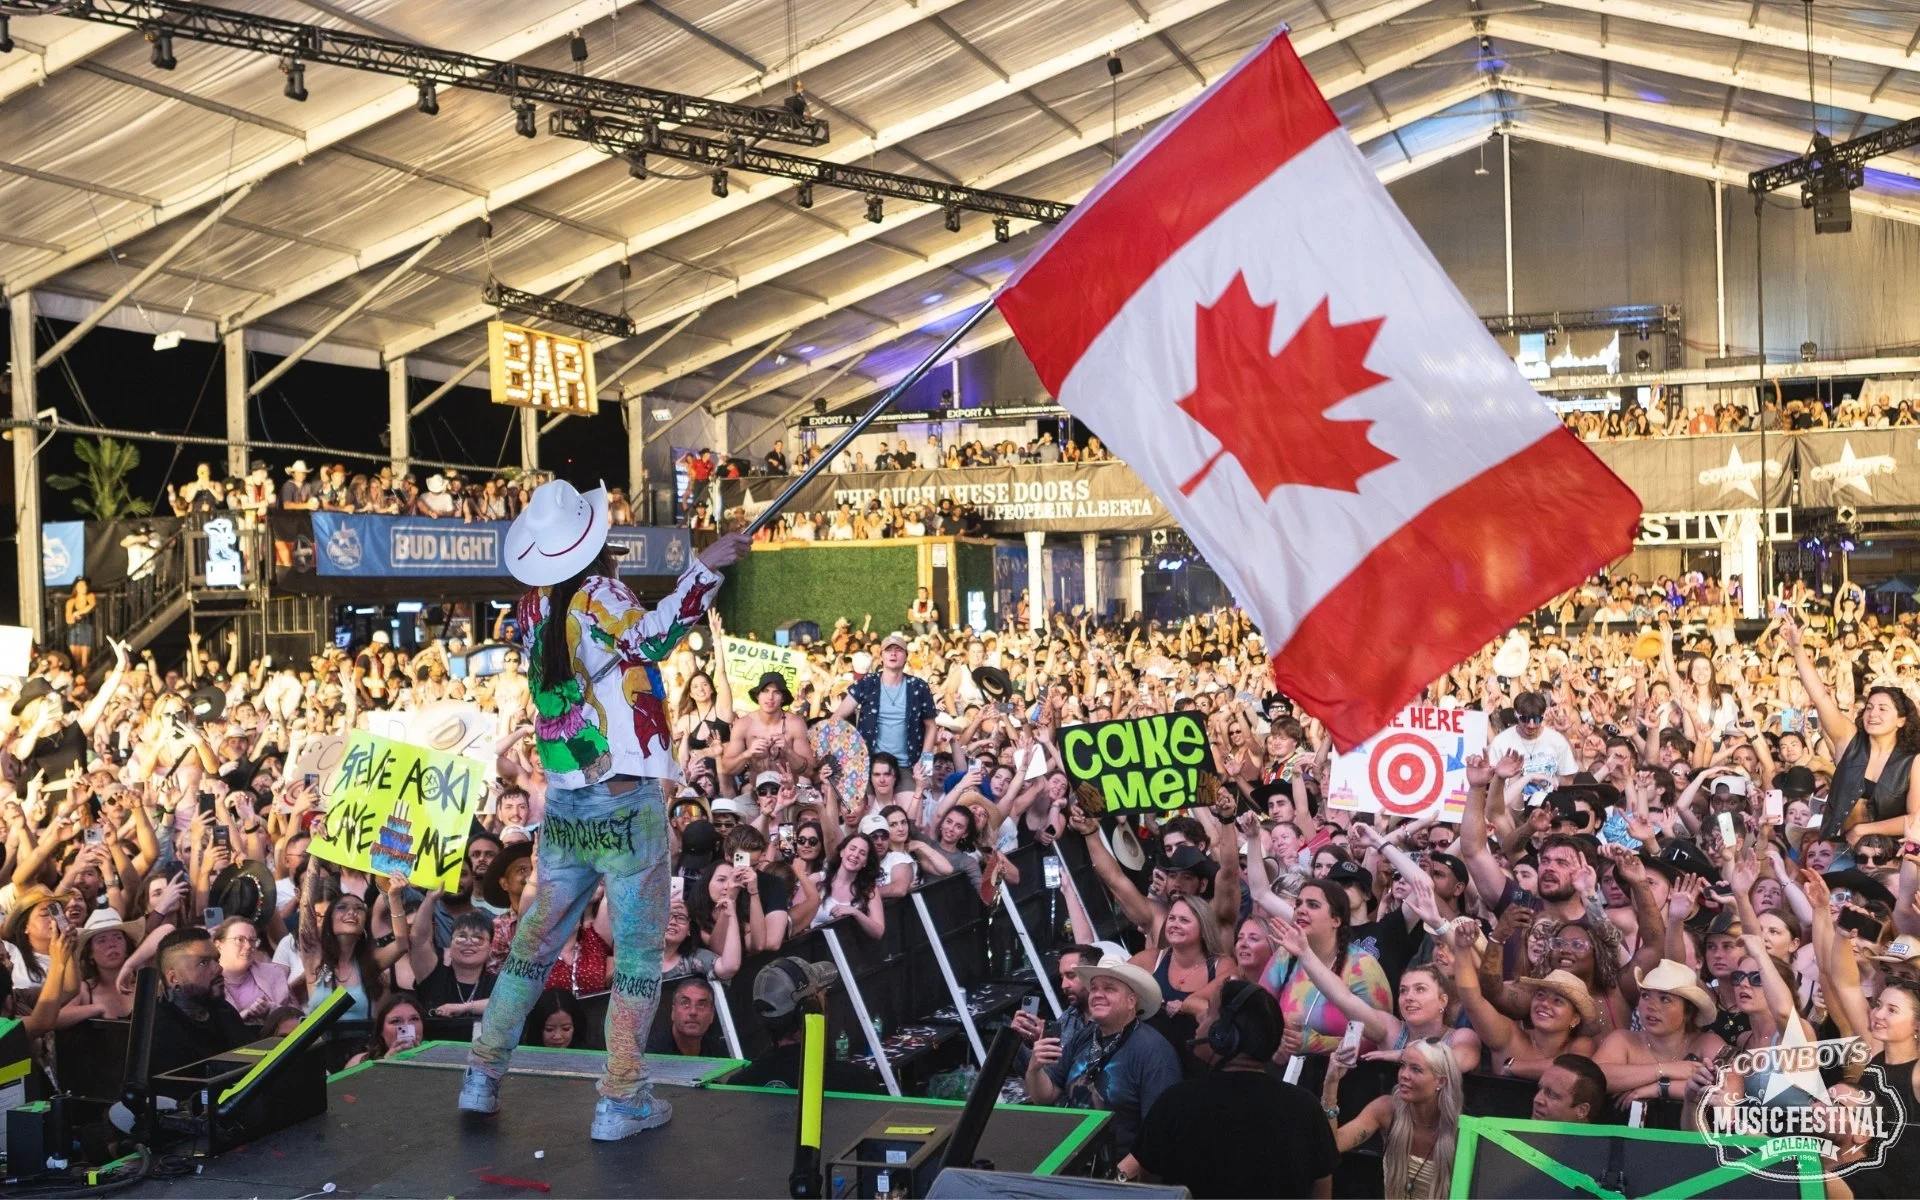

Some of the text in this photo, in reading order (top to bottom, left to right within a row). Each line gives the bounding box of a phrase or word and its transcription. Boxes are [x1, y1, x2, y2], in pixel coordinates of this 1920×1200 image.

[502, 330, 588, 409] BAR
[1570, 373, 1613, 386] EXPORT
[1615, 374, 1624, 384] A
[809, 415, 843, 426] EXPORT
[845, 415, 852, 424] A
[946, 407, 983, 419] EXPORT
[984, 407, 992, 417] A
[1698, 458, 1783, 486] COWBOYS
[1810, 454, 1898, 482] COWBOYS
[940, 484, 1008, 504] THESE
[1014, 480, 1090, 502] DOORS
[994, 502, 1053, 521] PEOPLE
[1054, 501, 1073, 518] IN
[1076, 499, 1153, 518] ALBERTA
[1636, 507, 1792, 545] STIVAL
[395, 534, 493, 561] BUD LIGHT
[728, 643, 791, 664] DOUBLE
[1410, 707, 1464, 734] HERE
[333, 742, 396, 794] STEVE
[398, 757, 470, 815] AOKI
[414, 827, 463, 878] ME
